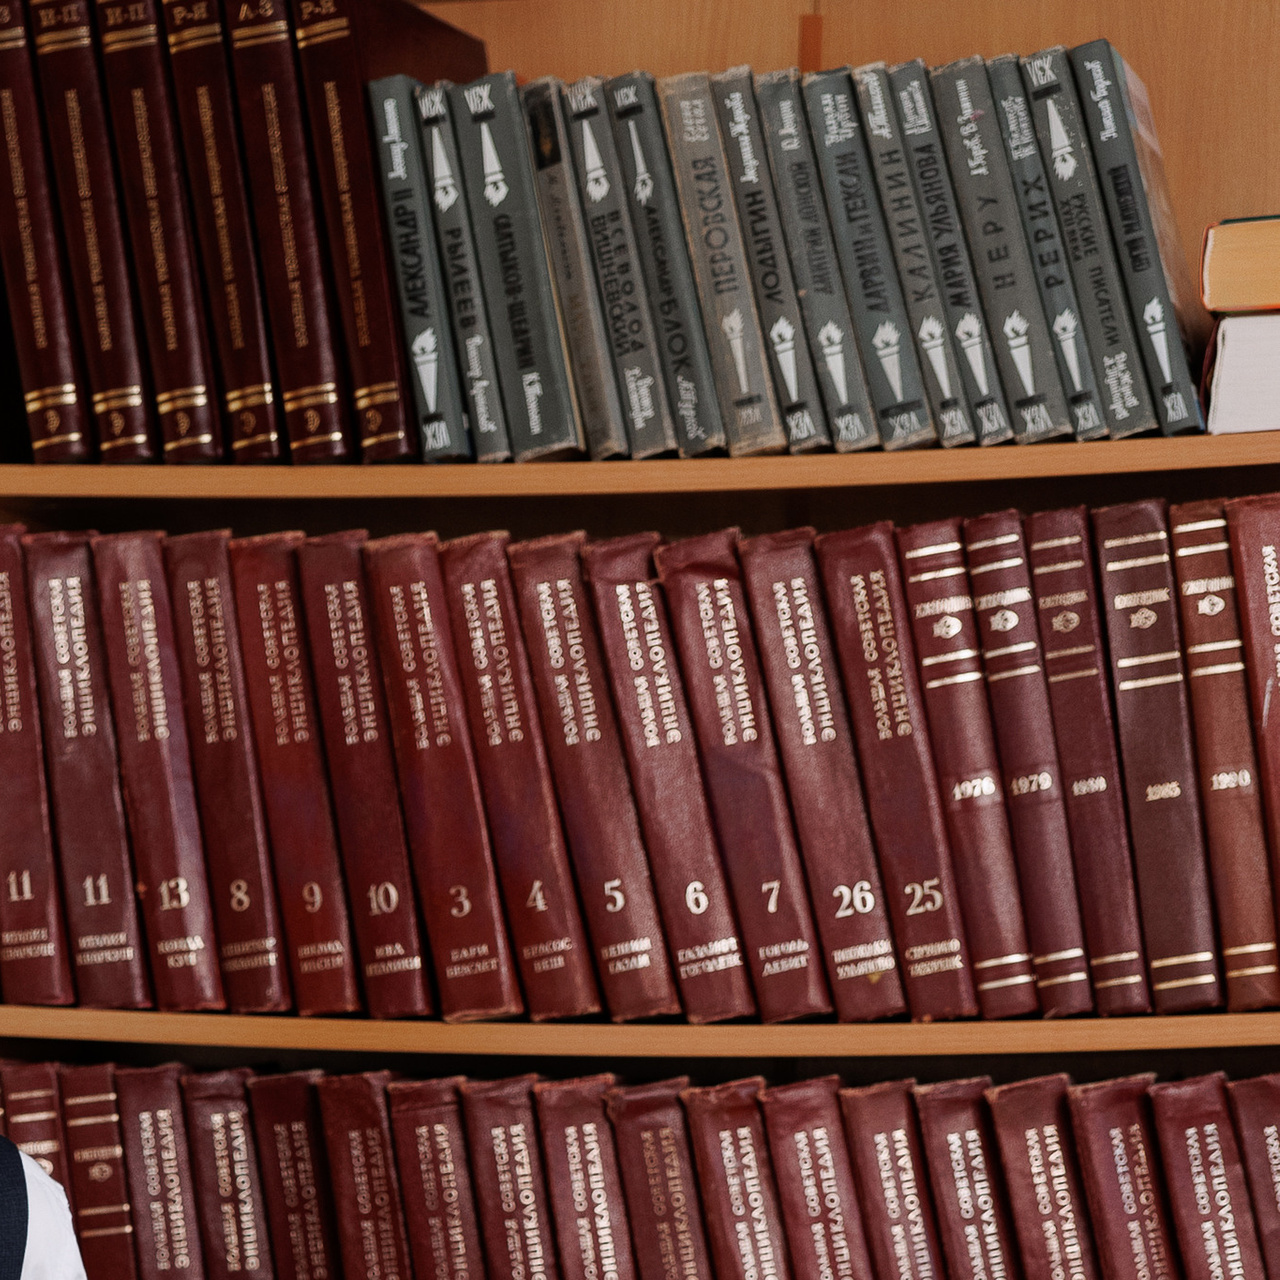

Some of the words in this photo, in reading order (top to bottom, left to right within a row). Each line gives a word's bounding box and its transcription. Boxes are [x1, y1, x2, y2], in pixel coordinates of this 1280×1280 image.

[836, 152, 868, 223] ГЕКСЛИ
[915, 143, 955, 241] УЛЬЯНОВА
[692, 156, 741, 295] ПЕРОВСКАЯ
[880, 148, 940, 304] КАЛИНИН
[977, 196, 1017, 290] НЕРУ
[1021, 176, 1065, 289] РЕРИХ
[392, 206, 429, 318] АЛЕКСАНДР
[745, 191, 785, 304] ЛОДЫГИН
[445, 227, 477, 330] РЫЛЕЕВ
[606, 210, 644, 352] ВСЕВОЛОД
[852, 239, 890, 313] ДАРВИН
[939, 243, 972, 307] МАРИЯ
[1088, 266, 1121, 347] ПИСАТЕЛИ
[952, 775, 996, 801] 1976
[7, 870, 35, 902] 11
[82, 873, 112, 905] 11
[159, 876, 190, 910] 13
[230, 879, 251, 913] 8
[302, 881, 323, 913] 9
[368, 881, 399, 916] 10
[449, 886, 472, 918] 3
[525, 879, 549, 913] 4
[602, 879, 626, 912] 5
[685, 881, 709, 915] 6
[761, 881, 782, 913] 7
[833, 881, 875, 919] 26
[904, 878, 943, 916] 25
